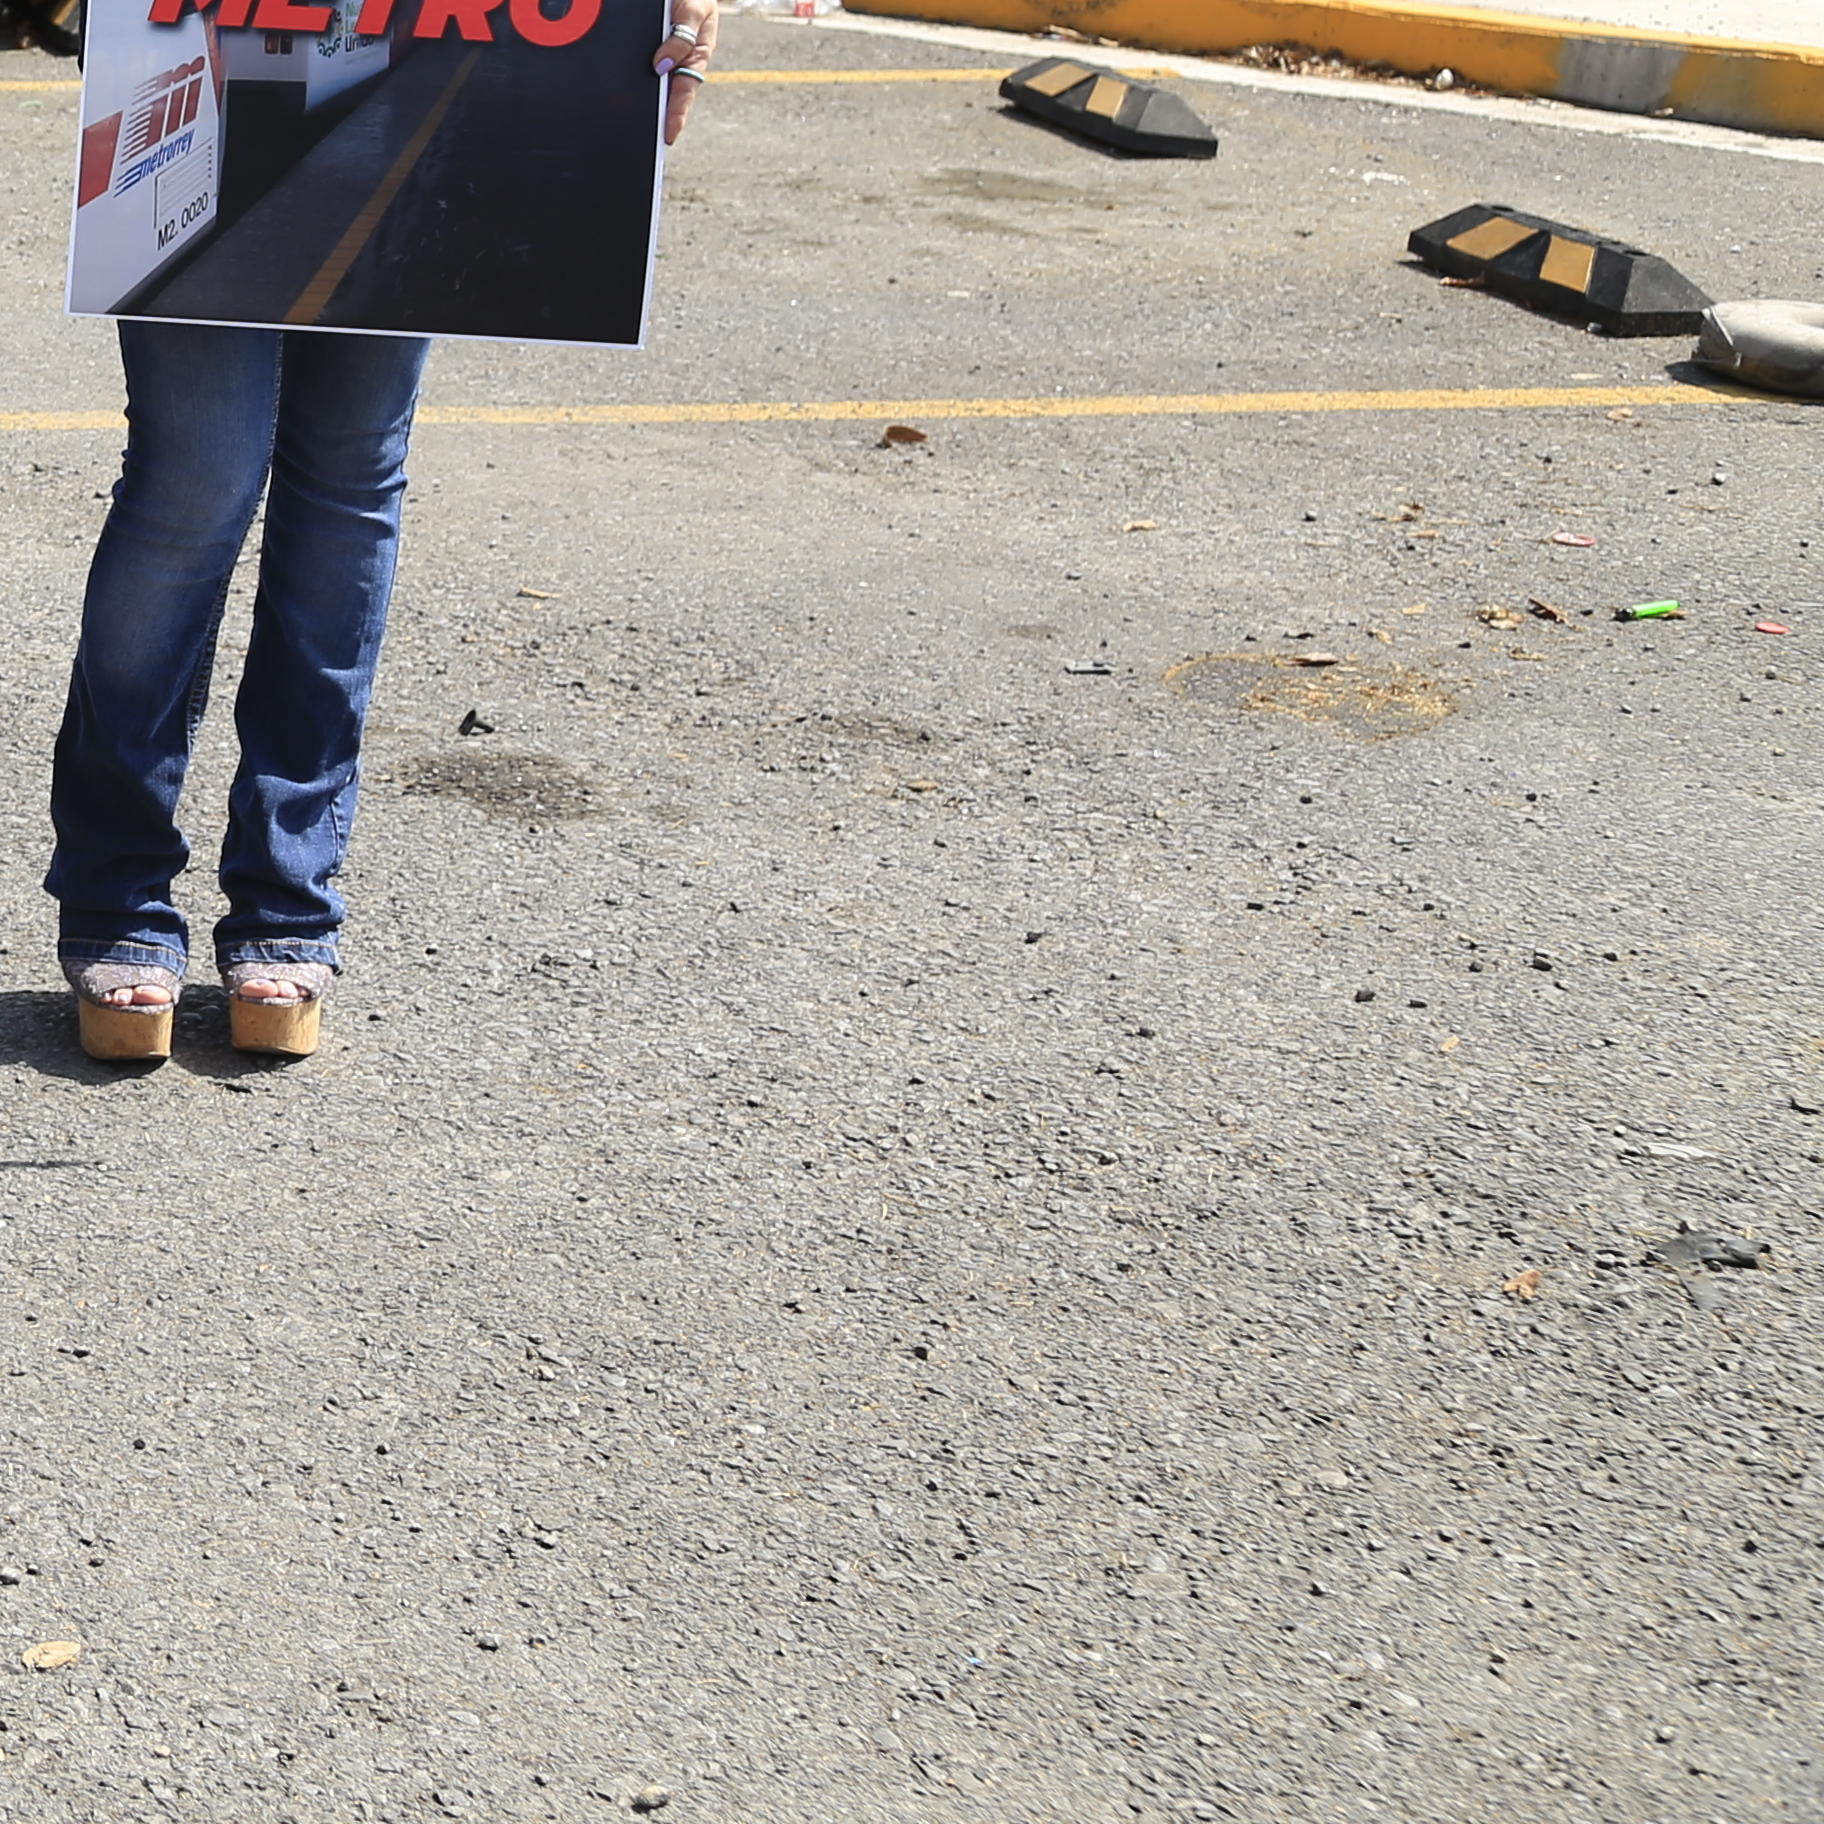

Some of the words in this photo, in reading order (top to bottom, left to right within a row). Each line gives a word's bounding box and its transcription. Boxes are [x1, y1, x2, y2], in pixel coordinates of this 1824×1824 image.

[124, 128, 195, 189] metrorrey
[157, 220, 179, 251] M2.
[181, 192, 209, 229] 0020
